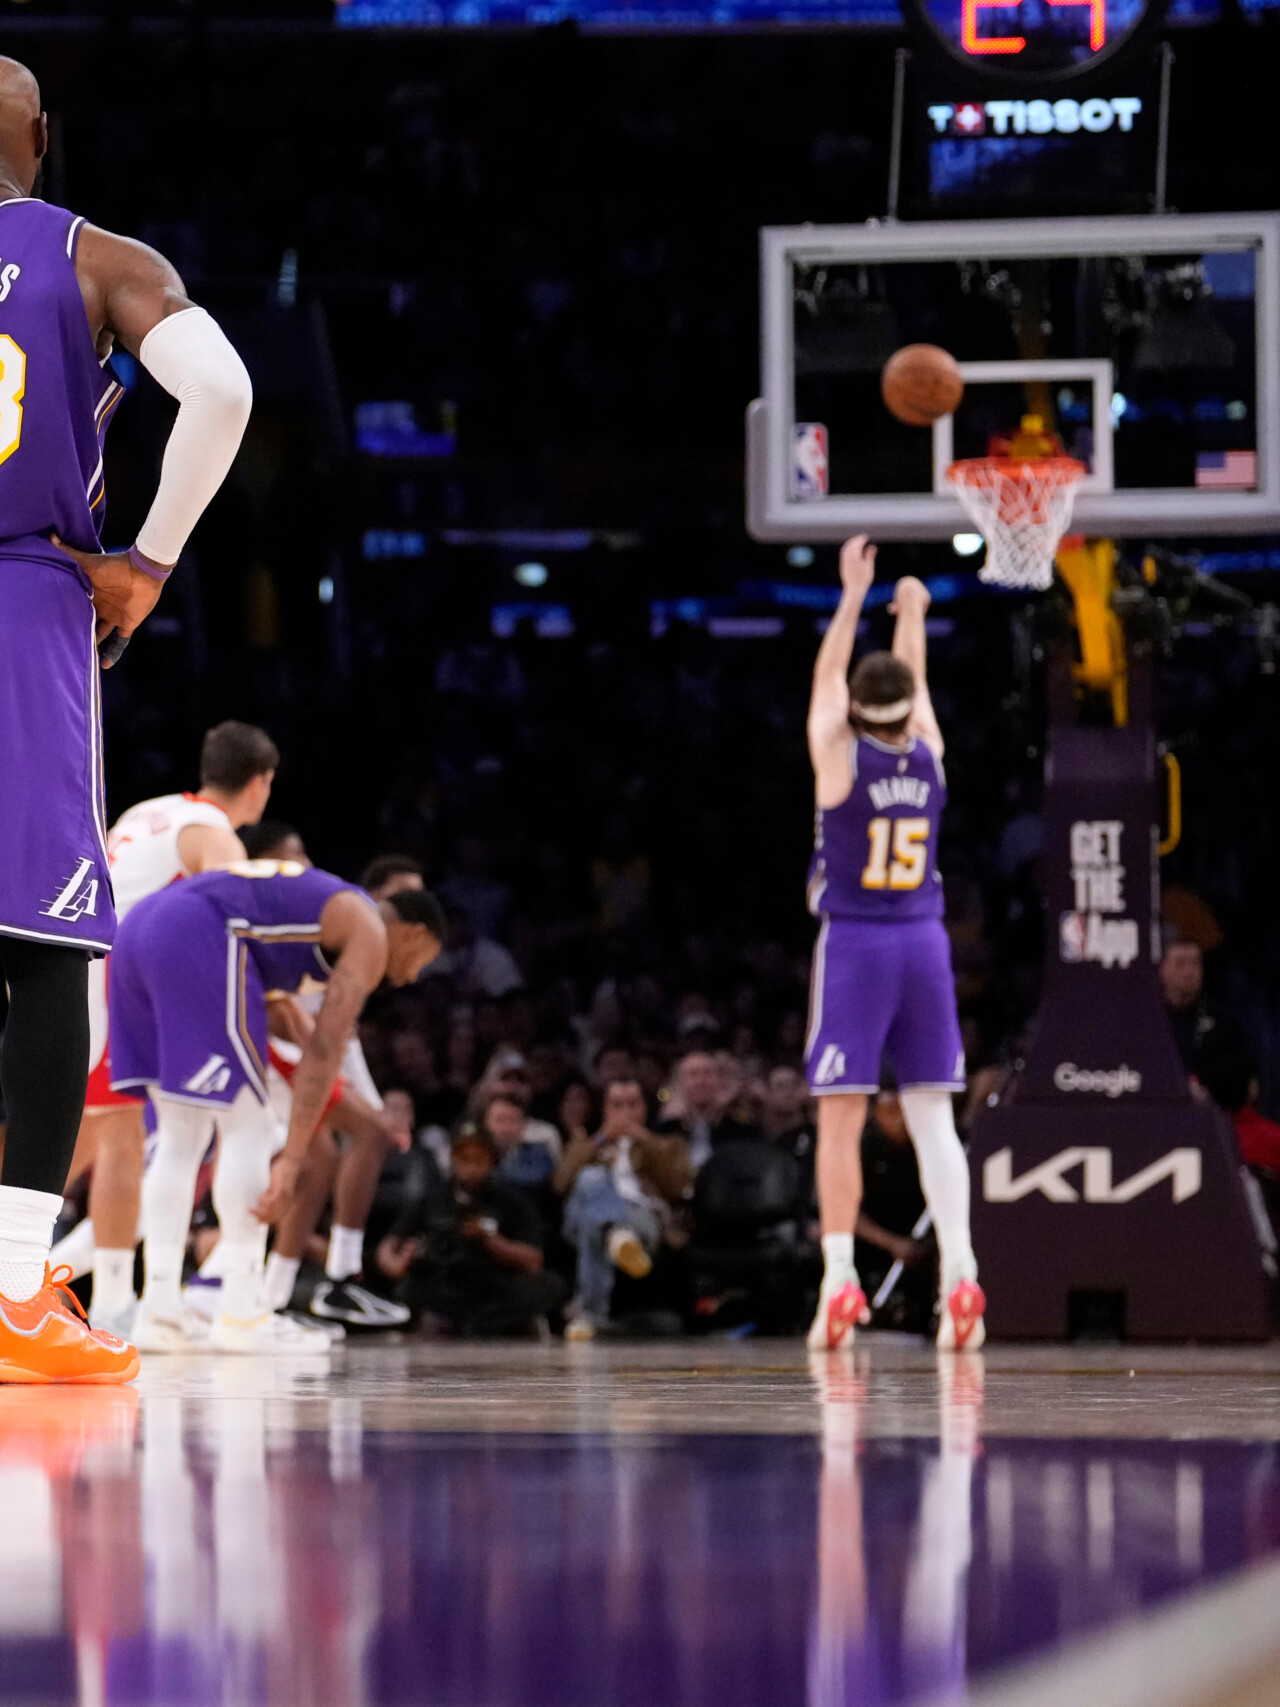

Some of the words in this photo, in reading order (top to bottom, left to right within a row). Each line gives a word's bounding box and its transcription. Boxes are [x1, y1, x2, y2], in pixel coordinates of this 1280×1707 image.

[985, 97, 1141, 134] TISSOT
[861, 817, 930, 890] 15
[1071, 820, 1124, 865] GET
[38, 856, 99, 922] LA
[1070, 865, 1126, 913] THE
[1054, 1062, 1142, 1098] Google
[983, 1146, 1202, 1204] KIA
